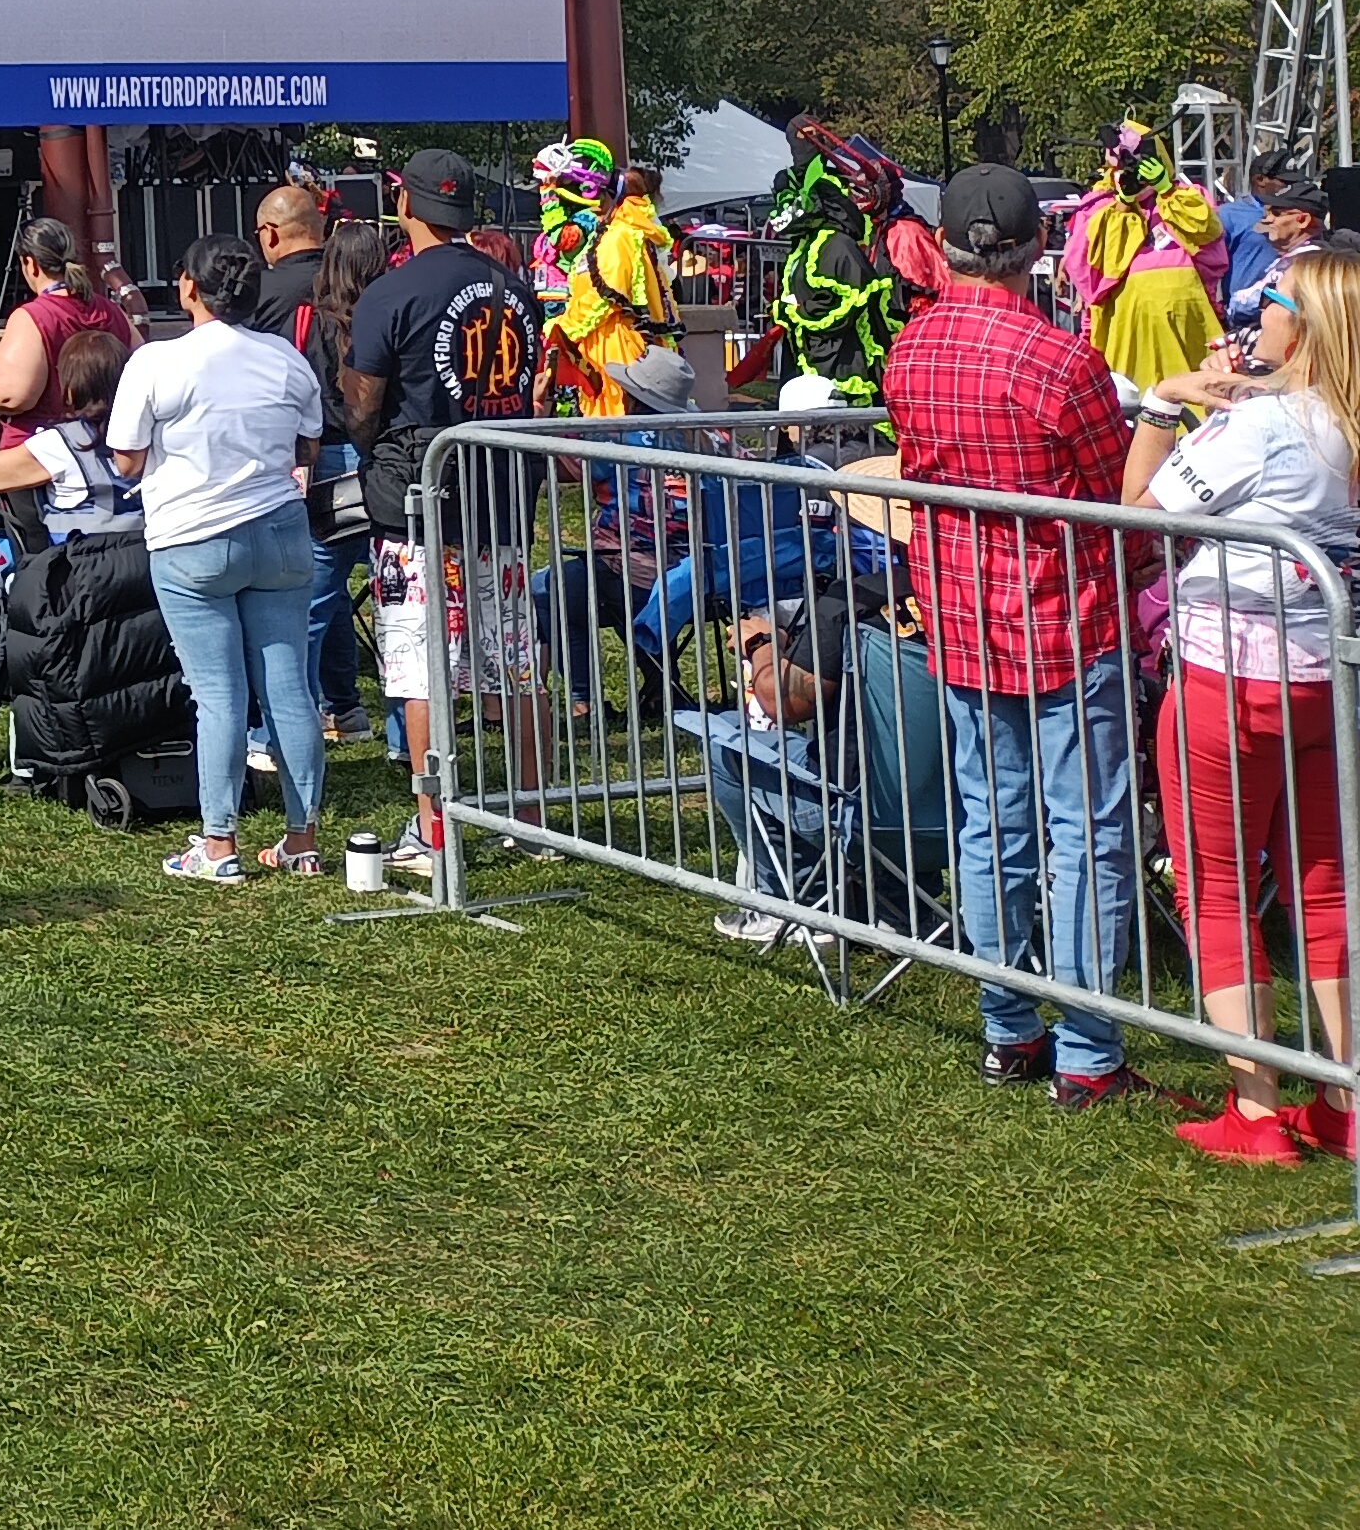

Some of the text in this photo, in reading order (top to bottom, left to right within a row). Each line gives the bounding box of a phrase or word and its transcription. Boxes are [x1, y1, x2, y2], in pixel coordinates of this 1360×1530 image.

[50, 76, 327, 108] WWW.HARTFORDPRPARADE.COM
[446, 282, 526, 320] FIREFIGHERS
[434, 320, 462, 400] HARTFORD
[1179, 465, 1214, 504] RICO
